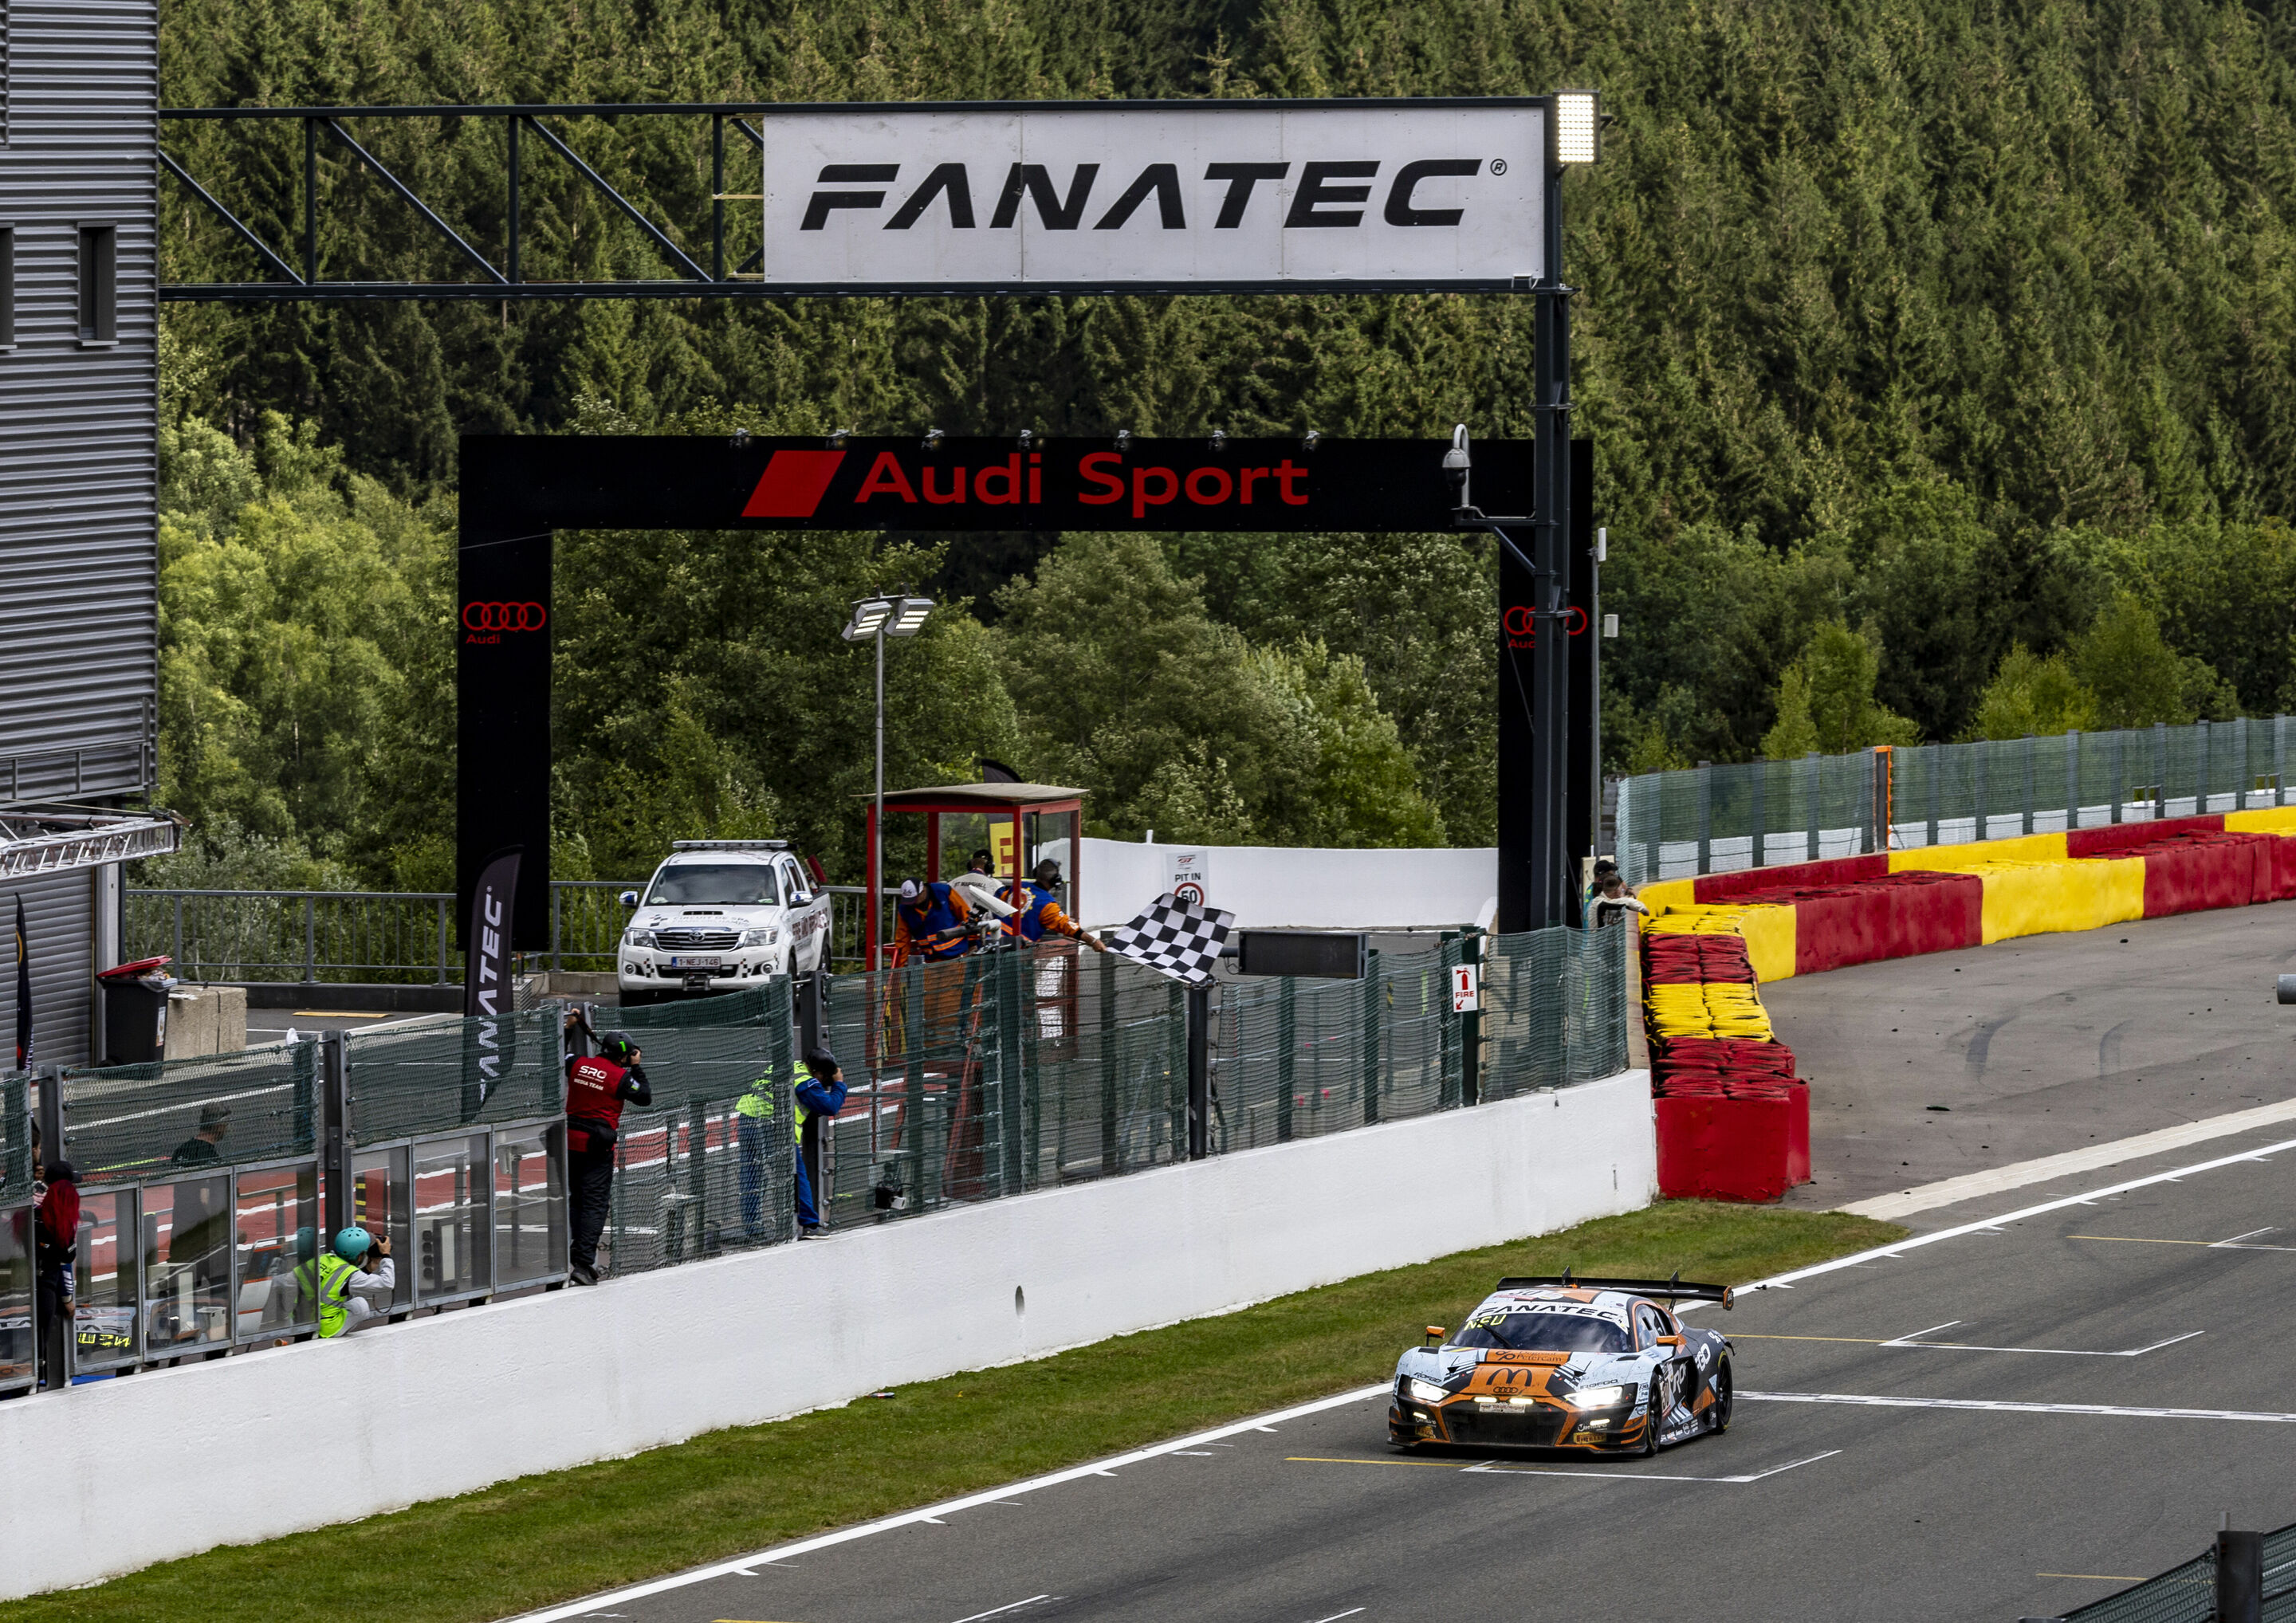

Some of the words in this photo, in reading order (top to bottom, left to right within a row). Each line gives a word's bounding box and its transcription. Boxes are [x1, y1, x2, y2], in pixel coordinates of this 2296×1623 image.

[854, 451, 1042, 504] Audi
[1078, 452, 1309, 518] Sport
[466, 634, 501, 644] Audi
[1191, 872, 1201, 881] IN
[1181, 890, 1197, 903] 50
[678, 957, 719, 966] 1-NEJ-146
[1455, 990, 1475, 999] FIRE
[579, 1065, 607, 1079] SRO
[589, 1082, 604, 1091] TEAM
[1478, 1304, 1623, 1320] FANATEC
